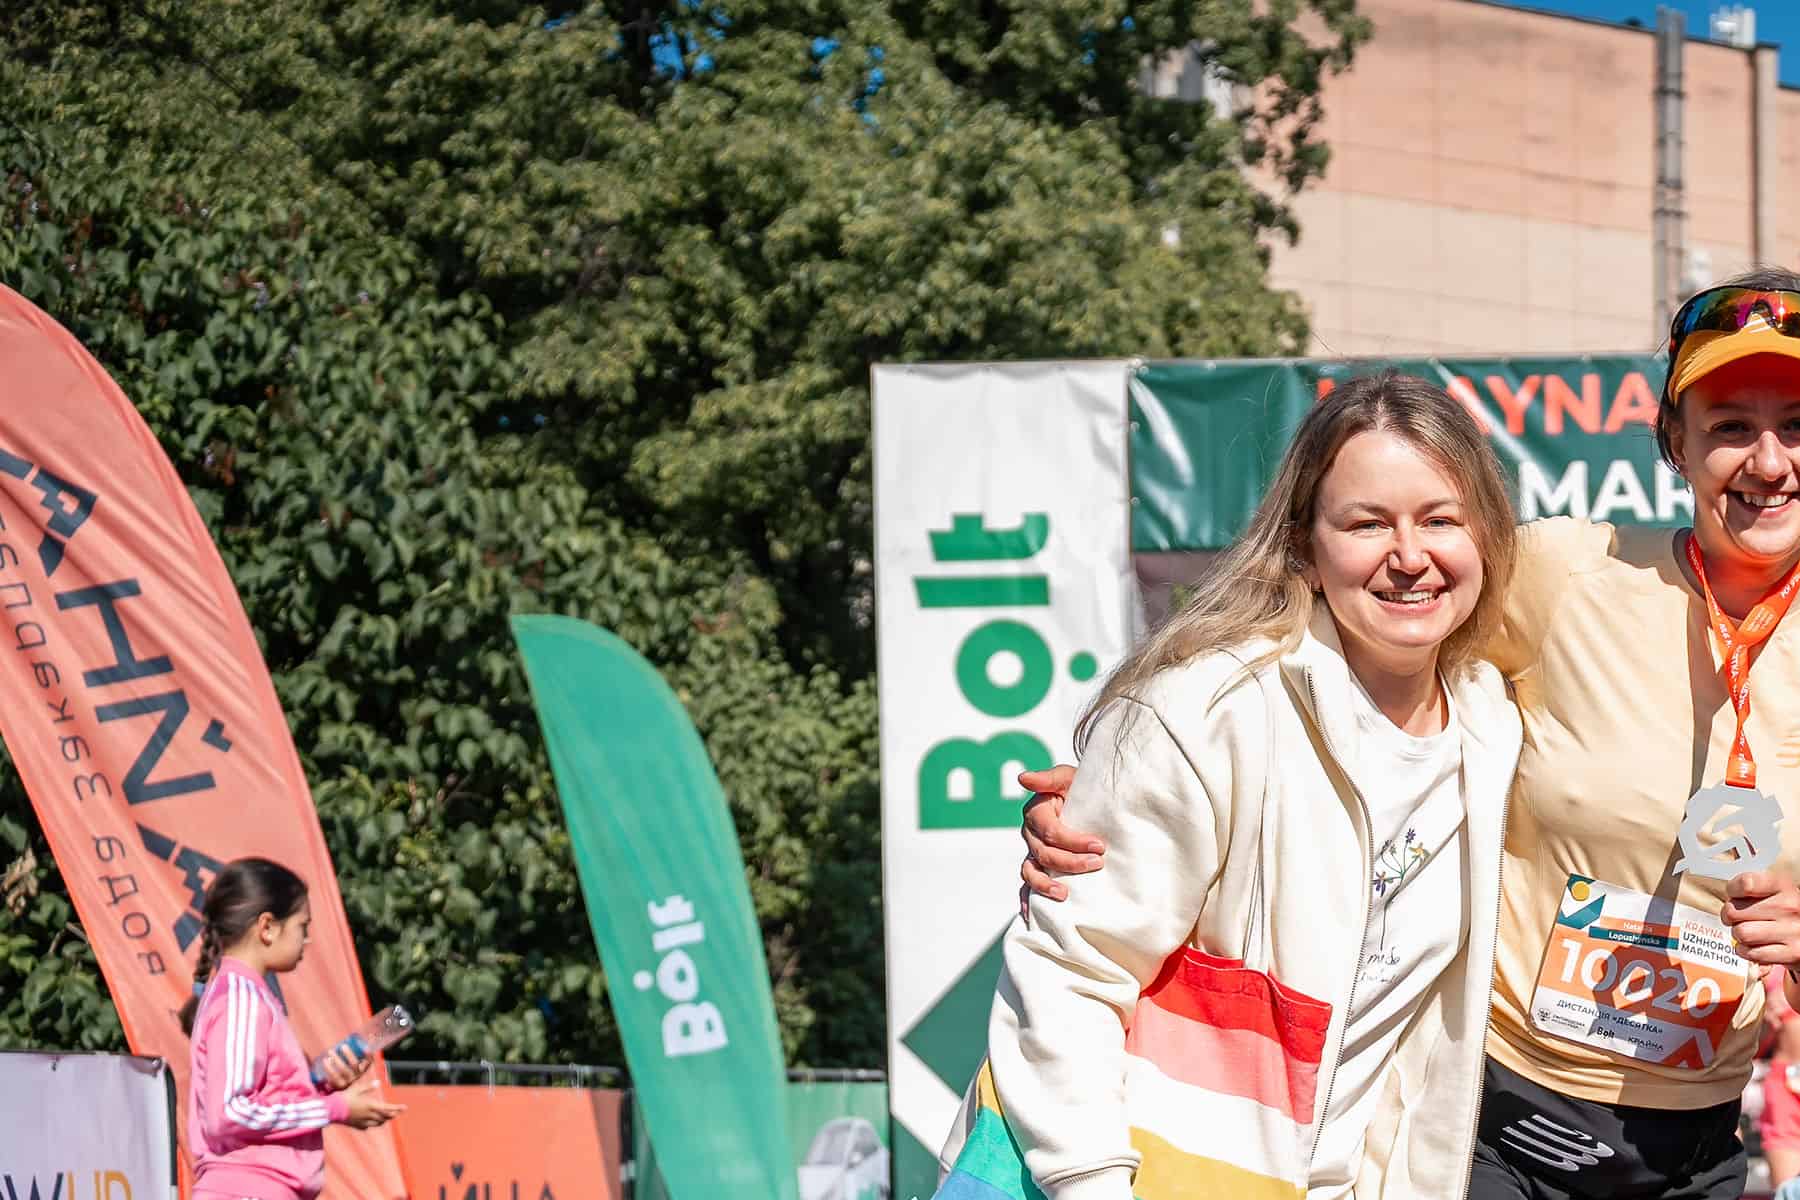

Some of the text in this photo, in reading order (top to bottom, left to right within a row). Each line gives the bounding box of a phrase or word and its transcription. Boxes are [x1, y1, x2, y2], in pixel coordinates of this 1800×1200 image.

[912, 512, 1098, 831] Bolt
[1684, 920, 1725, 940] KRAYNA
[1681, 943, 1739, 967] MARATHON
[1559, 937, 1722, 1019] 10020
[1556, 999, 1611, 1022] ДИСТАНЦІЯ
[1596, 1026, 1616, 1041] Bolt
